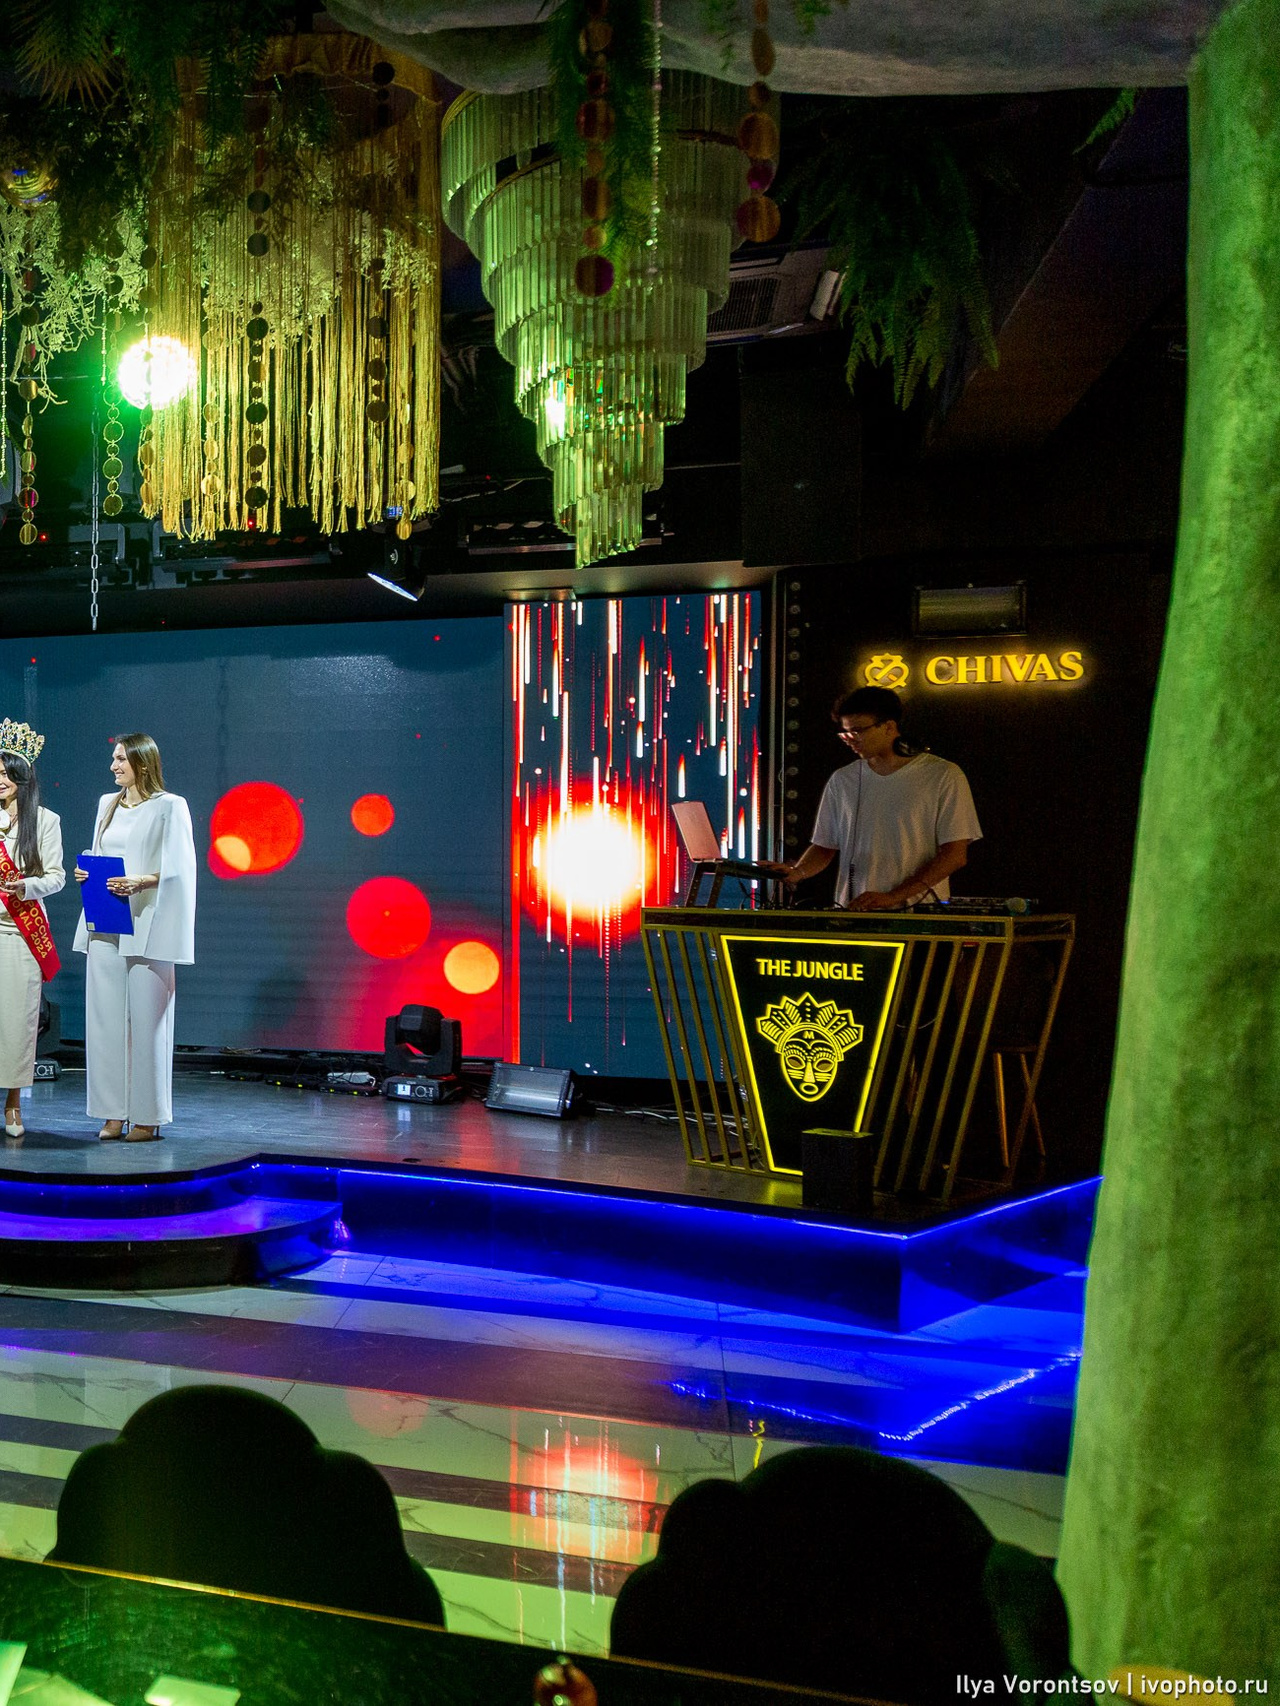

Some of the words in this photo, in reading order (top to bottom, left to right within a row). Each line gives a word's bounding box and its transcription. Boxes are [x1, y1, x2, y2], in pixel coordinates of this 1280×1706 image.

[925, 651, 1085, 685] CHIVAS
[24, 900, 53, 952] РОССИЯ
[30, 931, 48, 959] 2024
[756, 958, 791, 977] THE
[793, 961, 864, 981] JUNGLE
